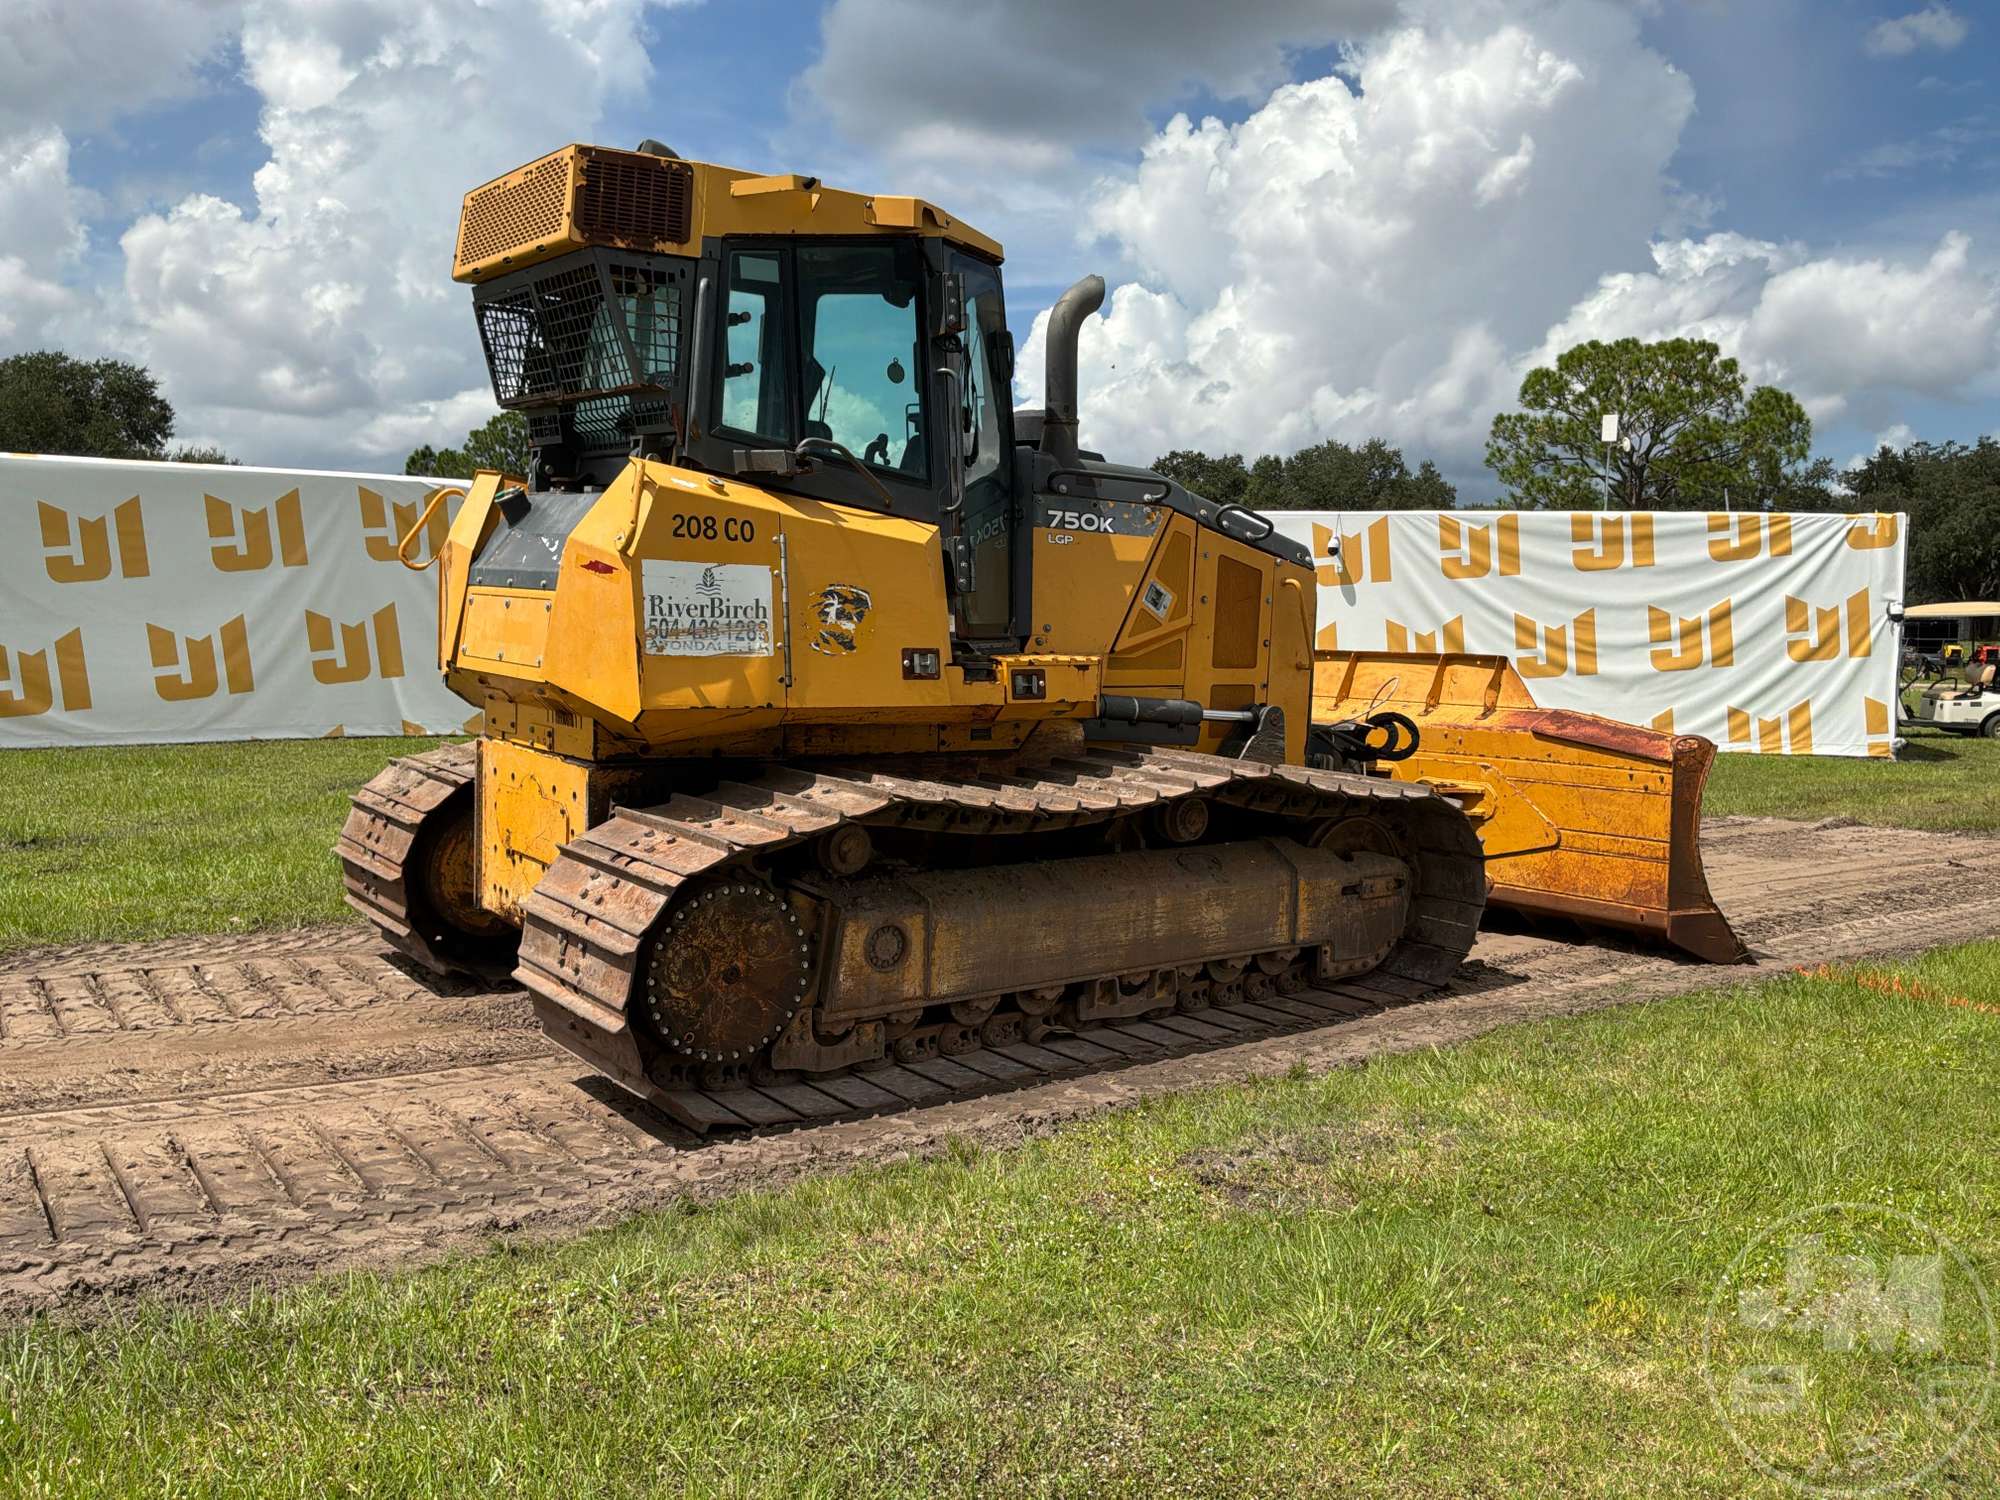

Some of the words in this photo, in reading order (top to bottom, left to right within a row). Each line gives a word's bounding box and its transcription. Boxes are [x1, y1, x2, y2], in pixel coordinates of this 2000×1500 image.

[672, 514, 718, 541] 208
[1047, 509, 1115, 534] 750K
[1047, 533, 1074, 545] LGP
[647, 594, 768, 619] RiverBirch
